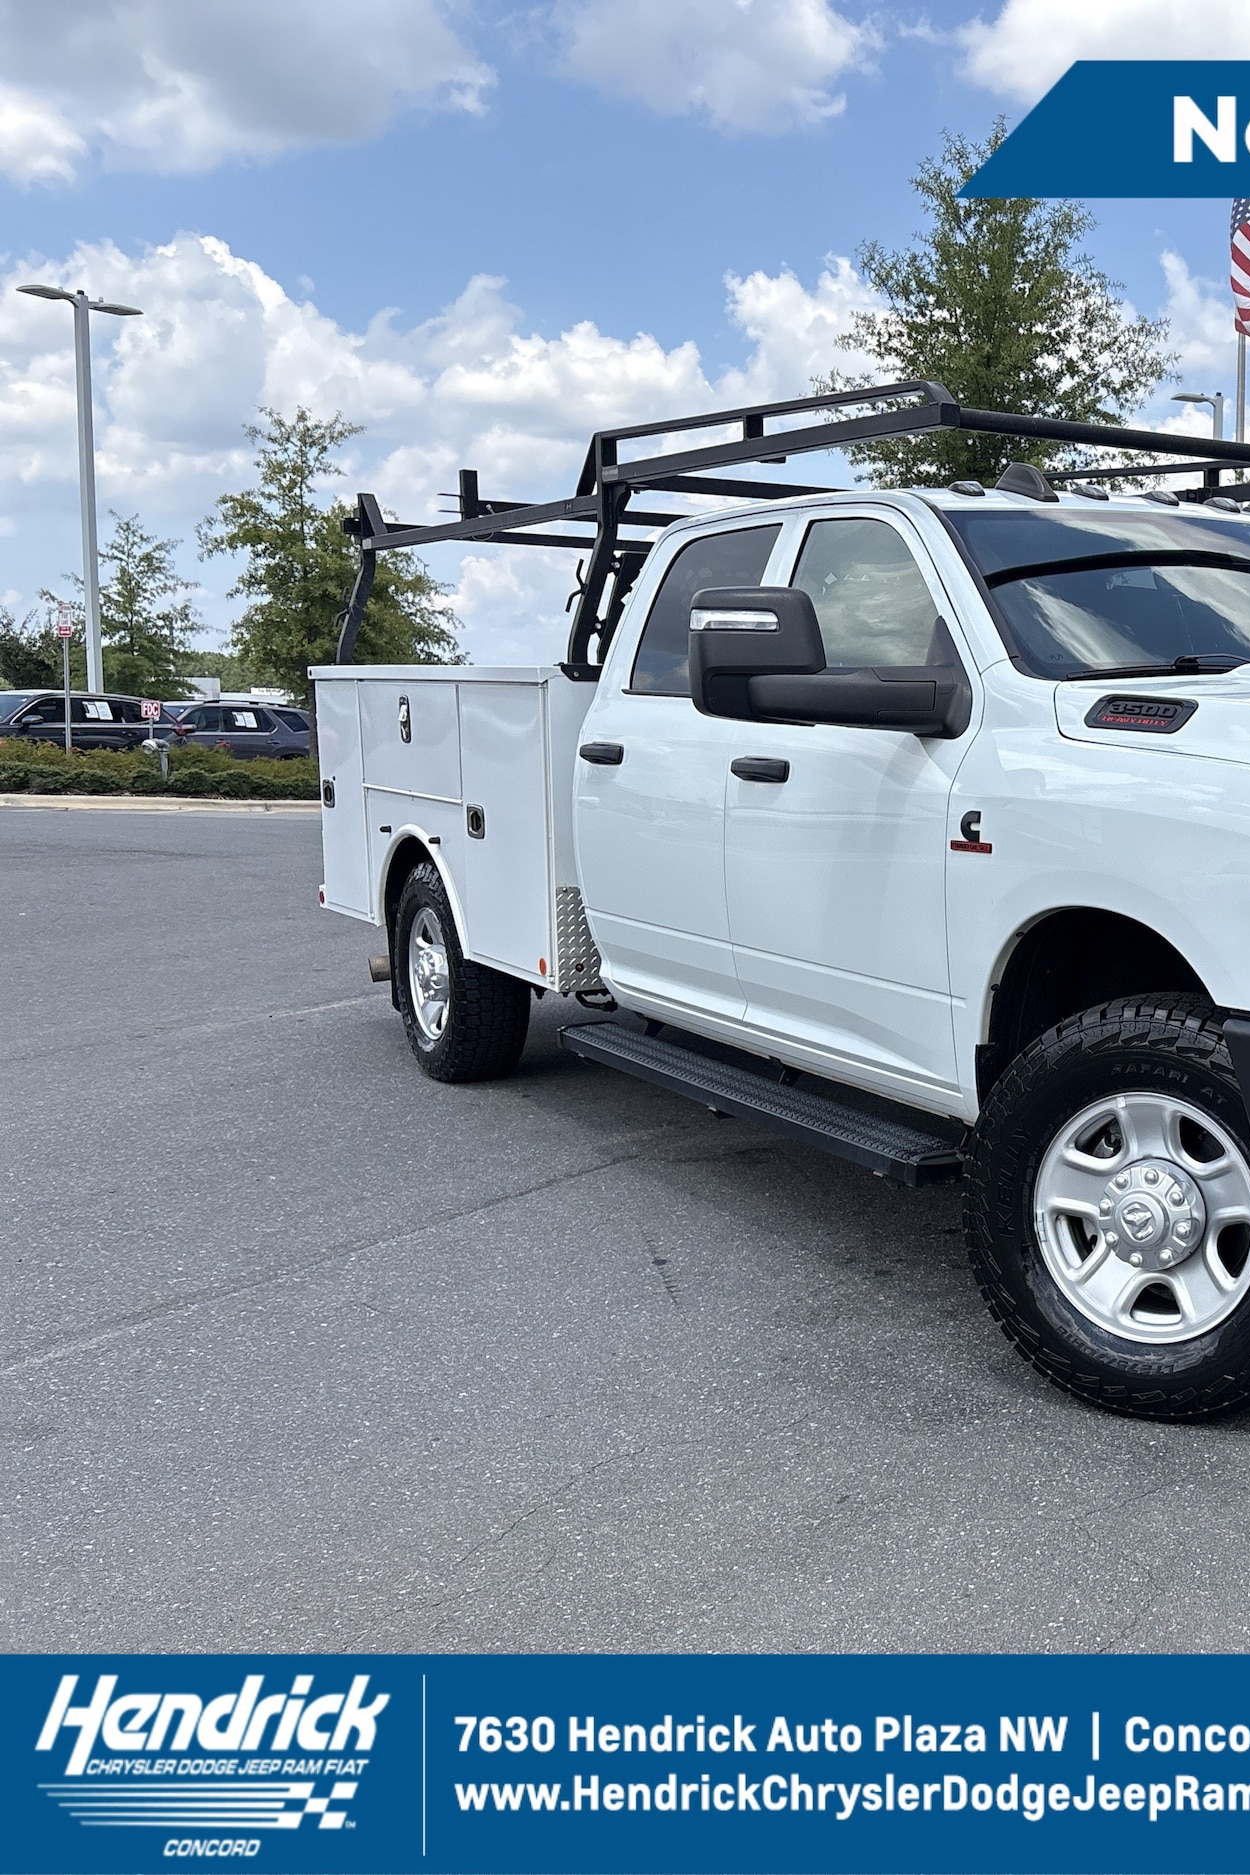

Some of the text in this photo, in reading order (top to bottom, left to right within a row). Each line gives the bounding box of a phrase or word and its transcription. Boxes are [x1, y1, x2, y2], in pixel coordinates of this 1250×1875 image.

[143, 703, 158, 716] FDC
[1110, 703, 1177, 718] 3500
[1110, 1063, 1190, 1084] SAFARI
